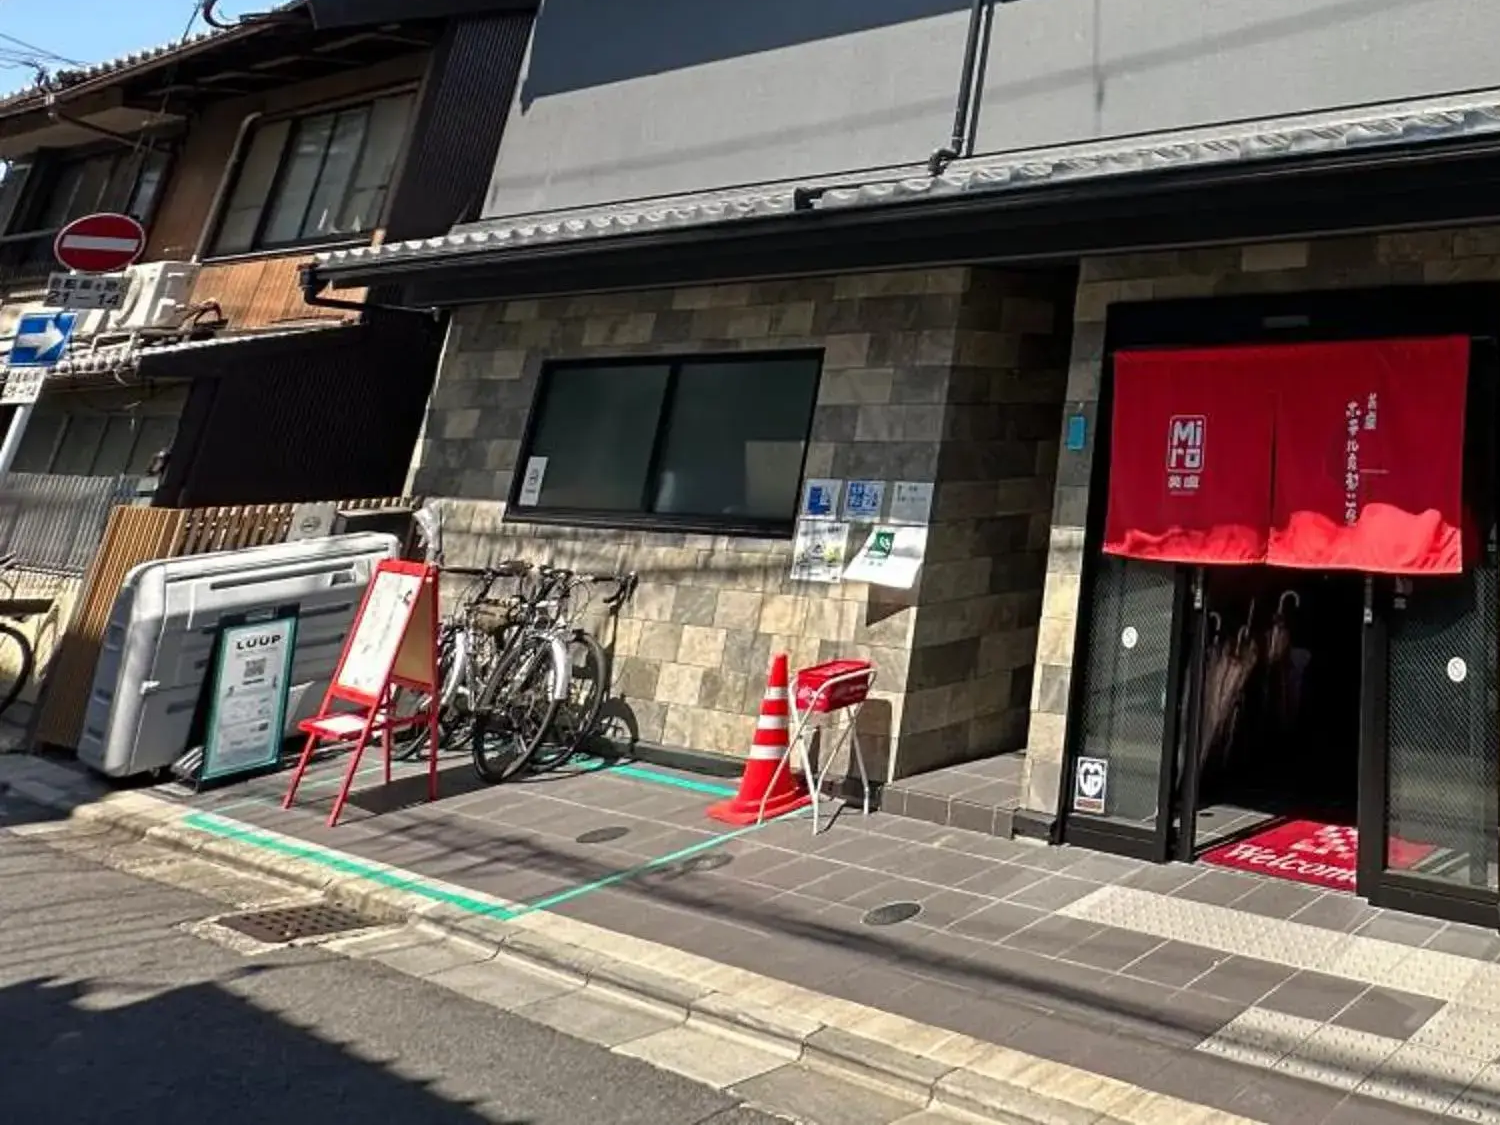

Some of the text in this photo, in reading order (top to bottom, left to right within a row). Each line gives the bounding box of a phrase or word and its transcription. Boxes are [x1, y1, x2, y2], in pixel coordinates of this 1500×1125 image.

[1172, 420, 1203, 446] Mi
[235, 634, 282, 651] LUUP
[1223, 842, 1357, 884] Welcom
